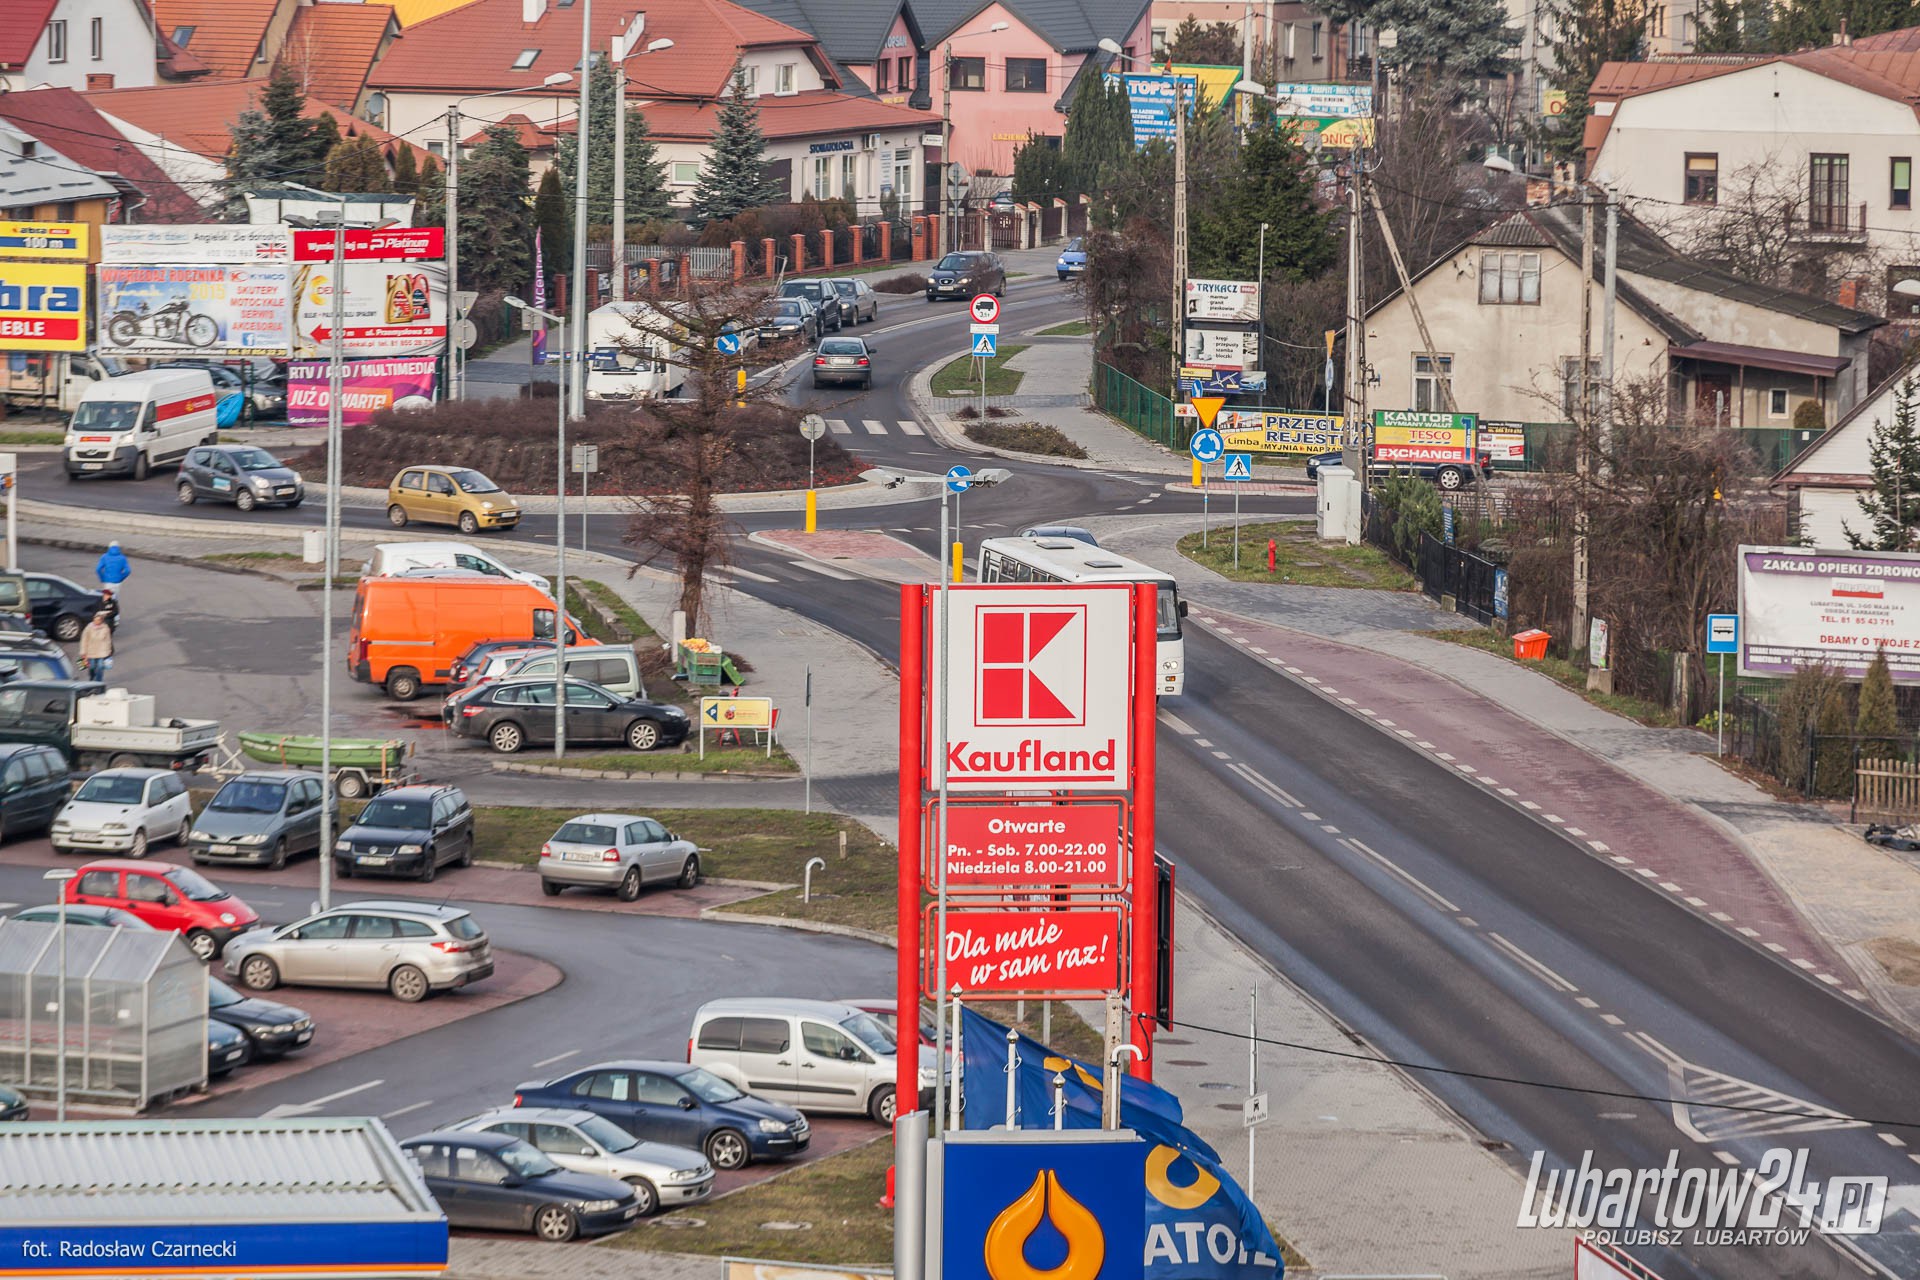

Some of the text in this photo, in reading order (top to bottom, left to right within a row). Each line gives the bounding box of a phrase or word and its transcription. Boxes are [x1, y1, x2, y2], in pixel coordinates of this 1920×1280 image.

[1128, 80, 1194, 96] TOPSN
[809, 141, 854, 154] STOMATOLOGIA
[23, 237, 64, 249] 100 m
[385, 238, 430, 249] Platinum
[169, 269, 225, 283] ROCZNIKA
[189, 284, 225, 300] 2015
[236, 286, 278, 295] SKUTERY
[1196, 283, 1238, 293] TRYKACZ
[230, 298, 285, 307] MOTOCYKLE
[240, 310, 275, 319] SERWIS
[231, 322, 283, 331] AKCESORIA
[289, 366, 314, 380] RTV
[326, 364, 351, 379] AD
[361, 361, 436, 377] MULTIMEDIA
[289, 386, 388, 410] JUŻ OWARTE!
[1383, 411, 1453, 423] KANTOR
[1409, 430, 1452, 440] TESCO
[1228, 438, 1259, 446] Limba
[1264, 444, 1299, 452] MYJNIA
[1378, 448, 1462, 460] EXCHANGE
[1762, 559, 1815, 573] ZAKŁAD
[1818, 563, 1862, 575] OPIEKI
[1820, 635, 1858, 645] DBAMY
[1861, 637, 1870, 646] O
[1872, 638, 1910, 648] TWOJE
[946, 739, 1116, 772] Kaufland
[988, 819, 1066, 834] Otwarte
[947, 844, 971, 857] Pn.
[987, 844, 1020, 857] Sob.
[1025, 843, 1106, 856] 7.00-22.00
[947, 861, 1106, 874] Niedziela 8.00-21.00
[945, 918, 1063, 962] Dla mnie
[970, 935, 1109, 986] w sam raz!
